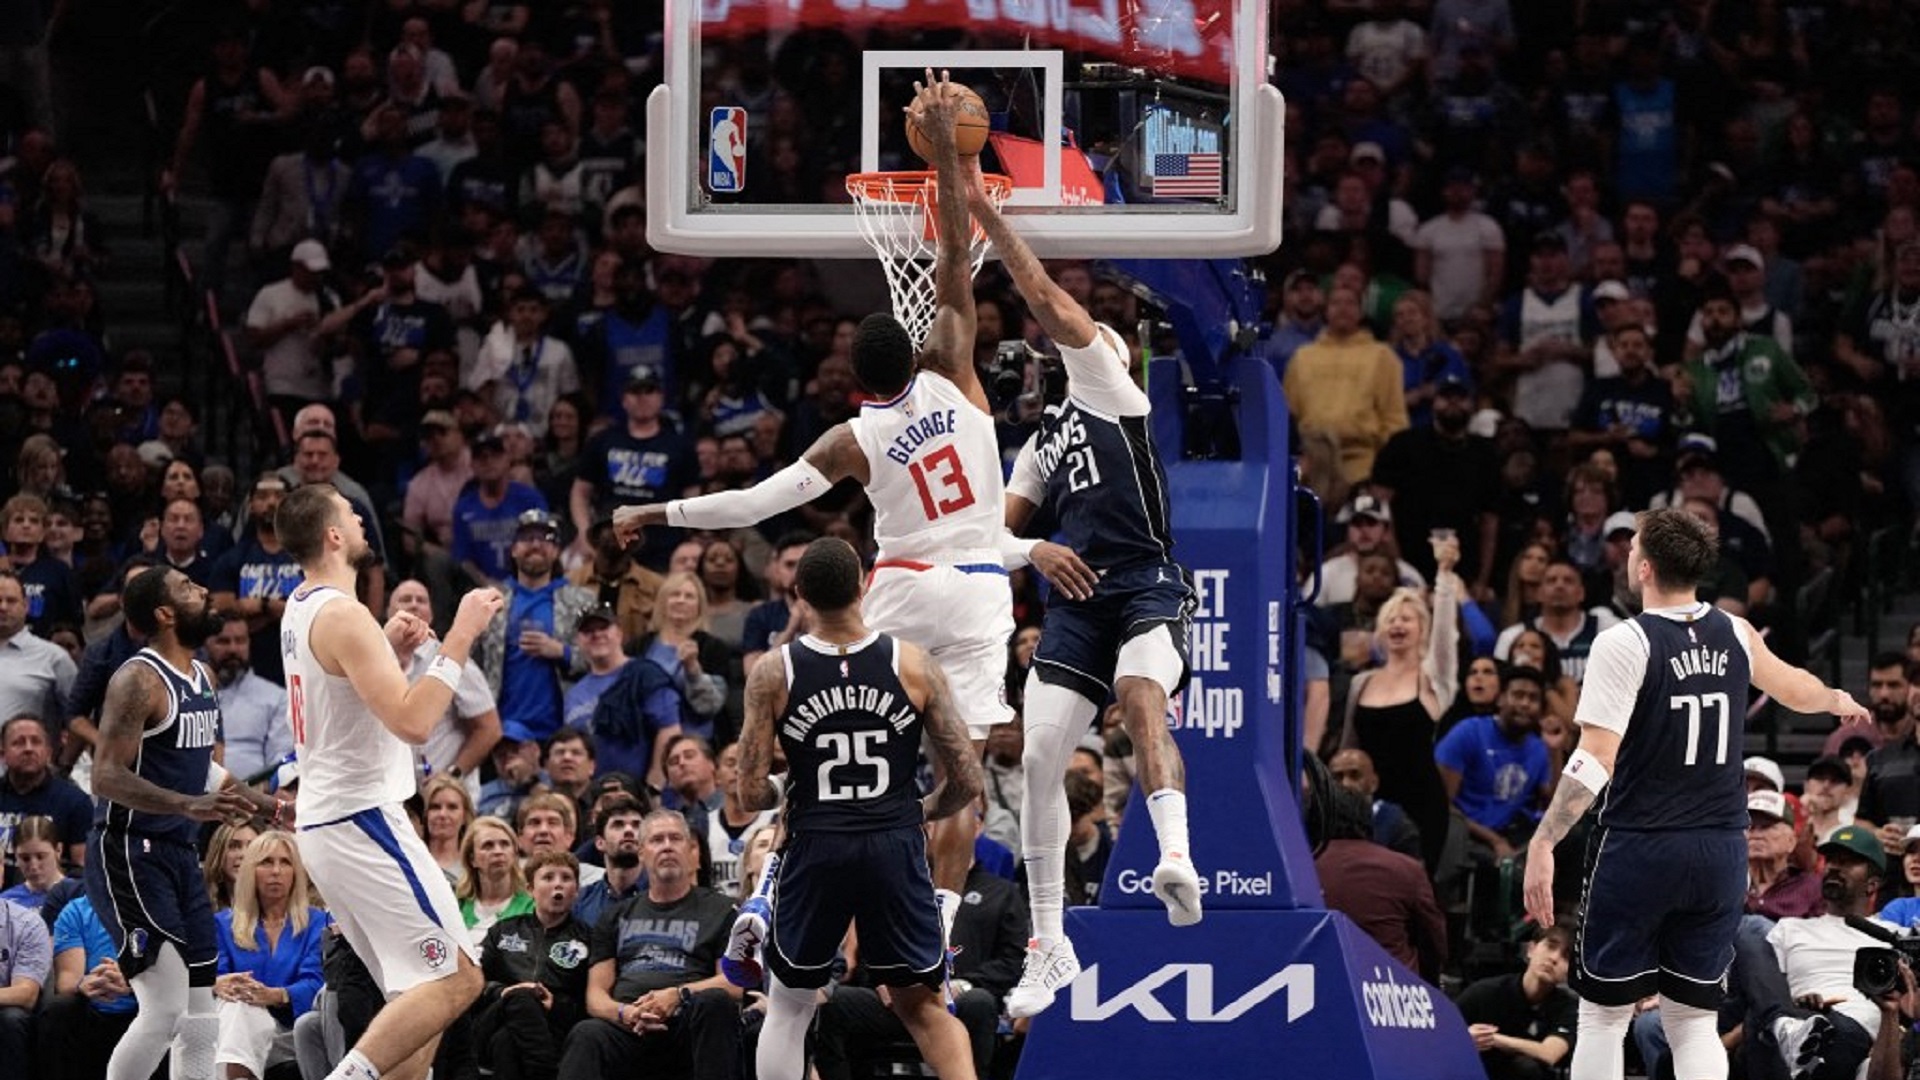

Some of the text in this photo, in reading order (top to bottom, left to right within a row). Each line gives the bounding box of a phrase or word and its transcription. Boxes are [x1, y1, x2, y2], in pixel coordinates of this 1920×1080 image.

[713, 171, 733, 187] NBA
[887, 409, 955, 466] GEORGE
[908, 444, 976, 521] 13
[1066, 445, 1100, 494] 21
[248, 577, 283, 600] ALL
[1194, 569, 1229, 618] ET
[1192, 623, 1231, 671] HE
[1669, 645, 1730, 681] DONČIĆ
[783, 684, 895, 743] WASHINGTON
[1186, 677, 1244, 738] App
[1670, 692, 1730, 766] 77
[815, 729, 890, 802] 25
[1216, 871, 1273, 896] Pixel
[617, 917, 700, 955] DALLAS
[1071, 963, 1315, 1024] KIA
[1362, 965, 1436, 1030] coinbase
